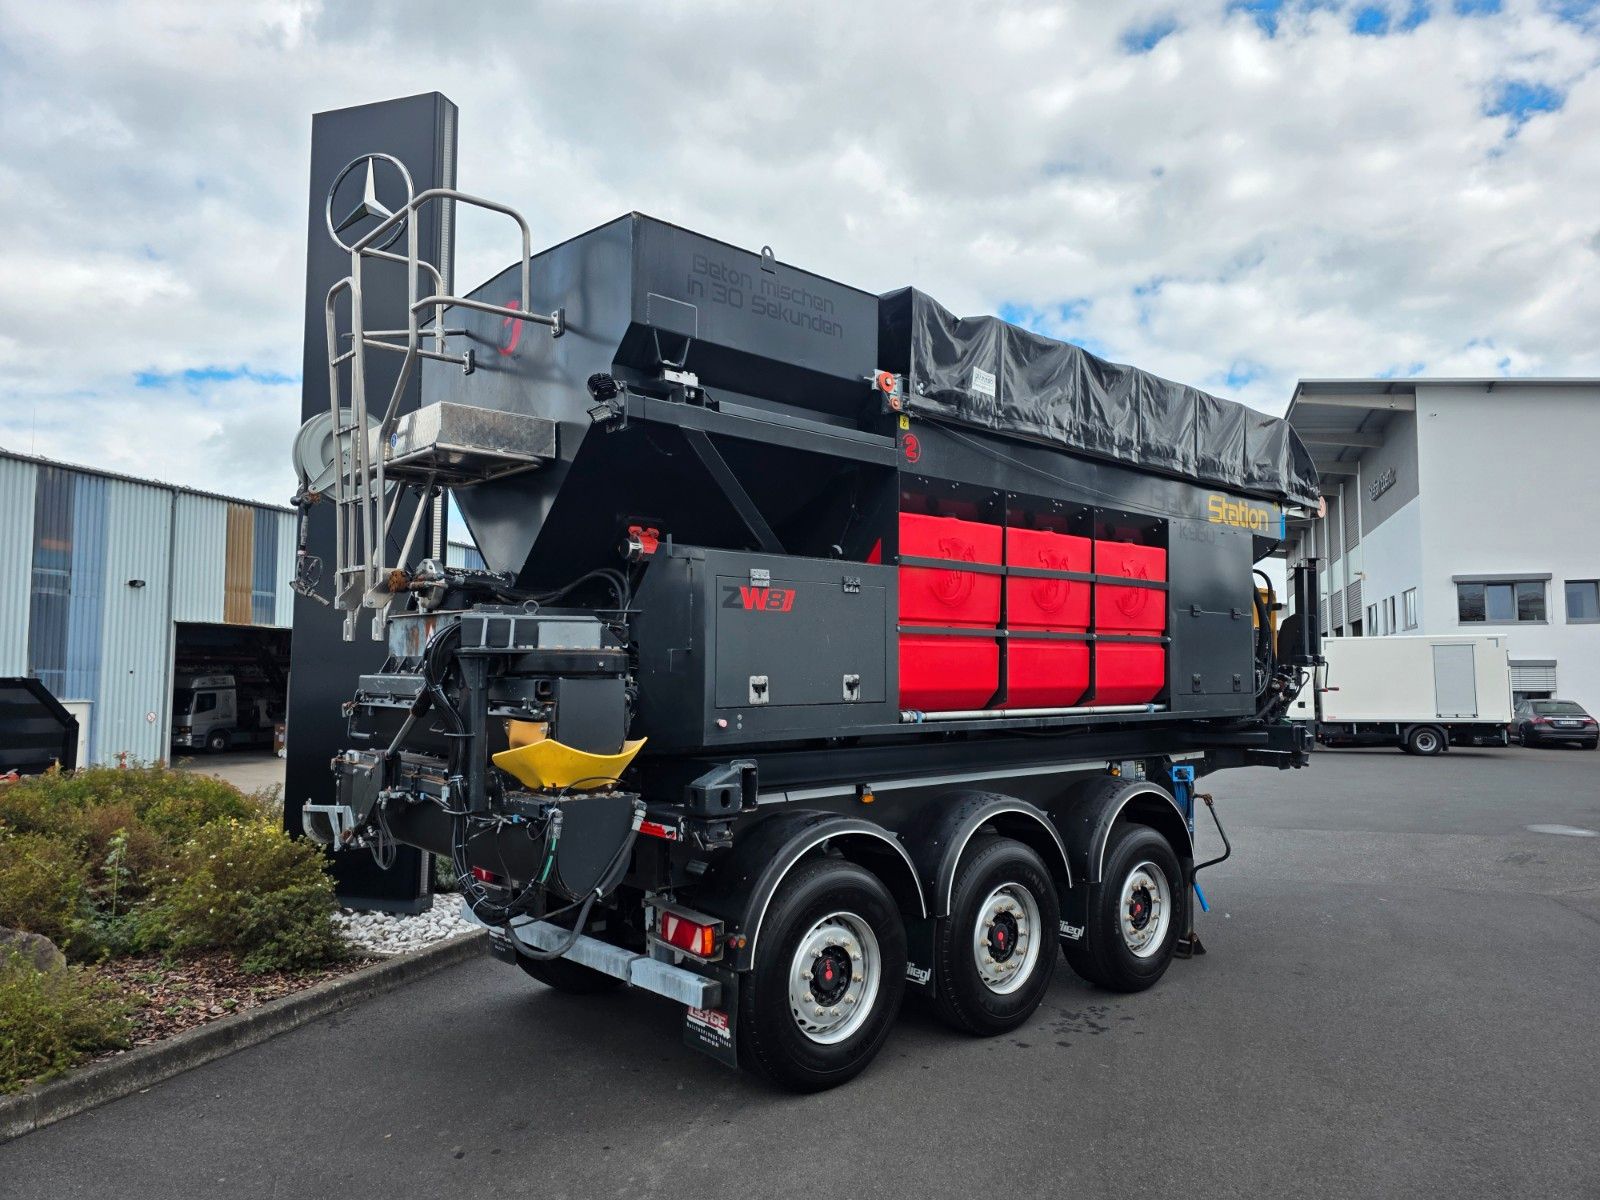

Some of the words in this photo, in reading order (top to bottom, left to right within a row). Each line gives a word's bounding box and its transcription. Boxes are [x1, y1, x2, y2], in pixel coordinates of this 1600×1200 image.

[687, 274, 704, 298] in
[712, 282, 744, 309] 30
[751, 294, 843, 338] Sekunden
[692, 253, 753, 290] Beton
[760, 277, 835, 315] mischen
[1208, 494, 1269, 532] Station
